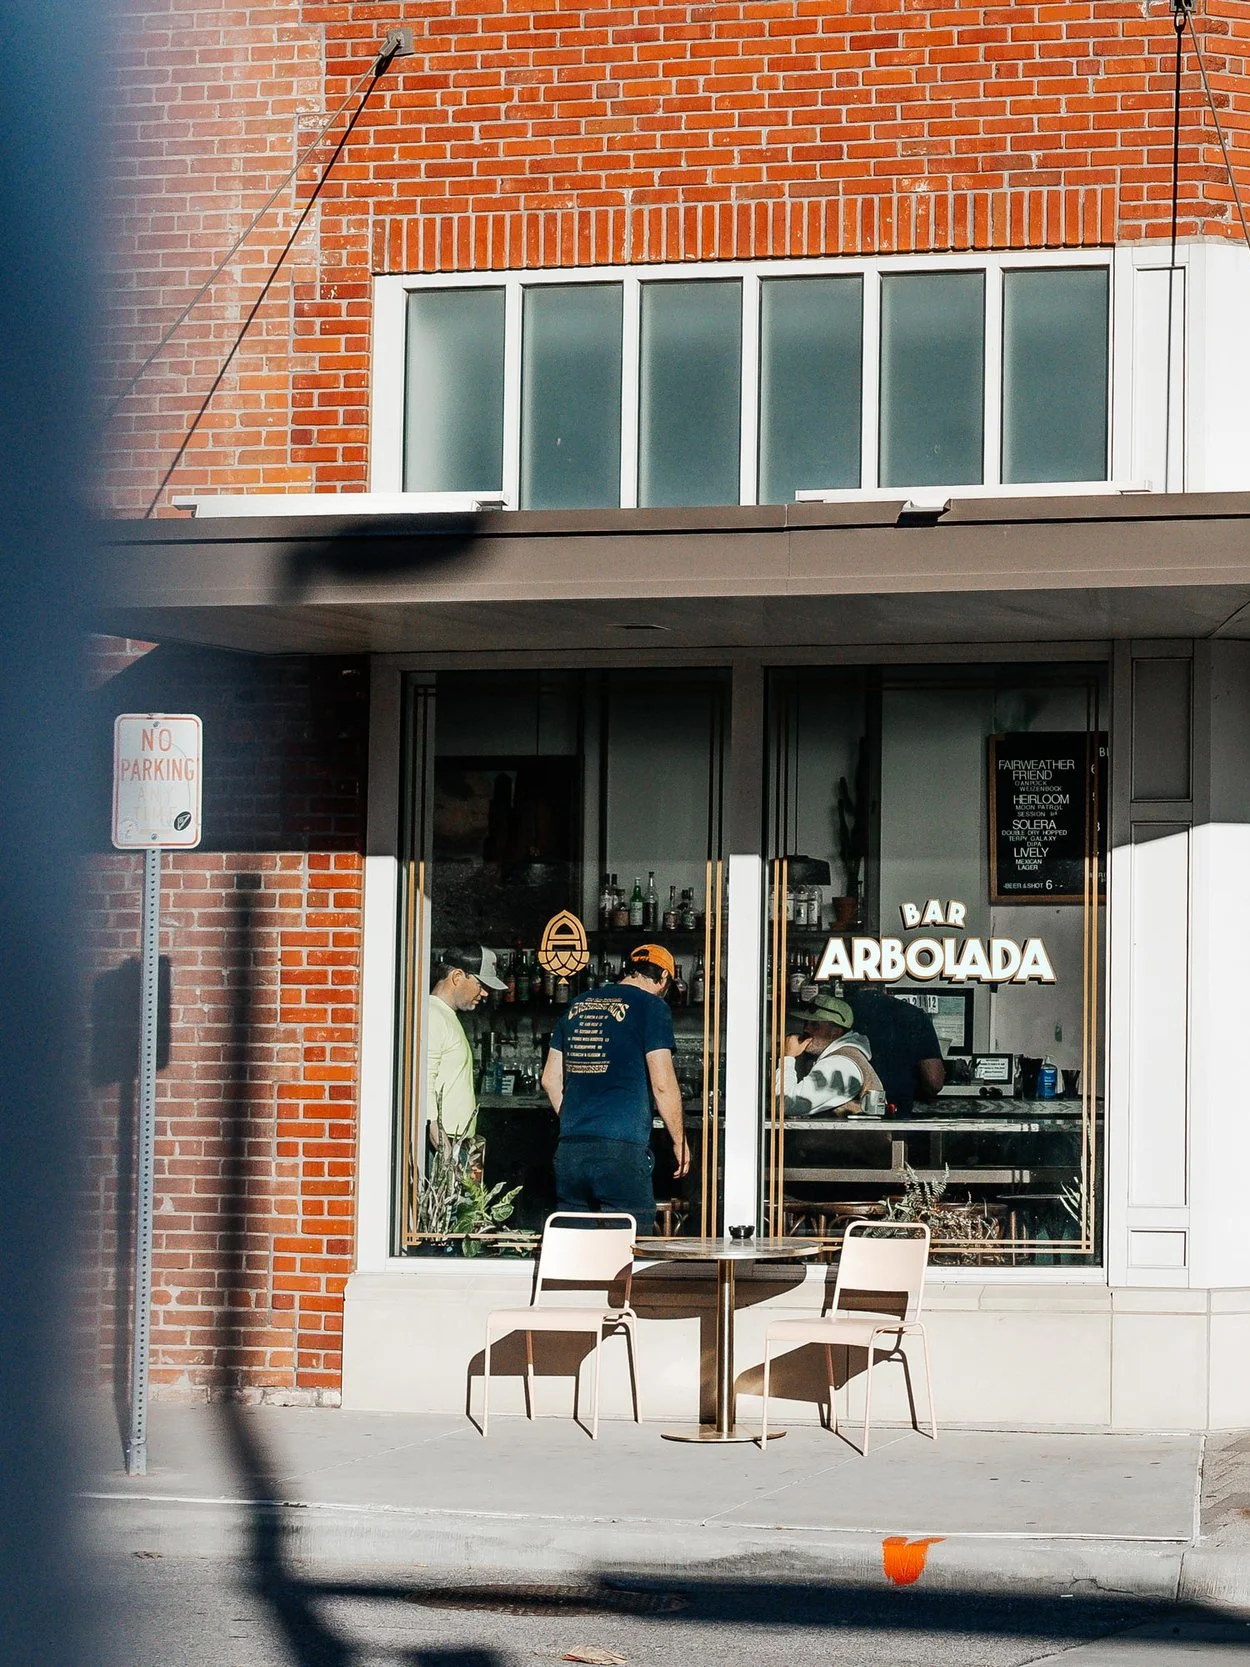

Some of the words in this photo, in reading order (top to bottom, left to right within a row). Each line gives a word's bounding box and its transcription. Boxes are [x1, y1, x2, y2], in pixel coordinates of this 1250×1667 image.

[141, 728, 172, 752] NO
[120, 758, 195, 781] PARKING
[998, 759, 1075, 770] FAIRWEATHER
[1012, 769, 1053, 781] FRIEND
[1013, 793, 1070, 805] HEIRLOOM
[1012, 819, 1057, 830] SOLERA
[1013, 847, 1049, 858] LIVELY
[1045, 879, 1053, 890] 6
[901, 899, 967, 929] BAR
[814, 936, 1057, 984] ARBOLADA
